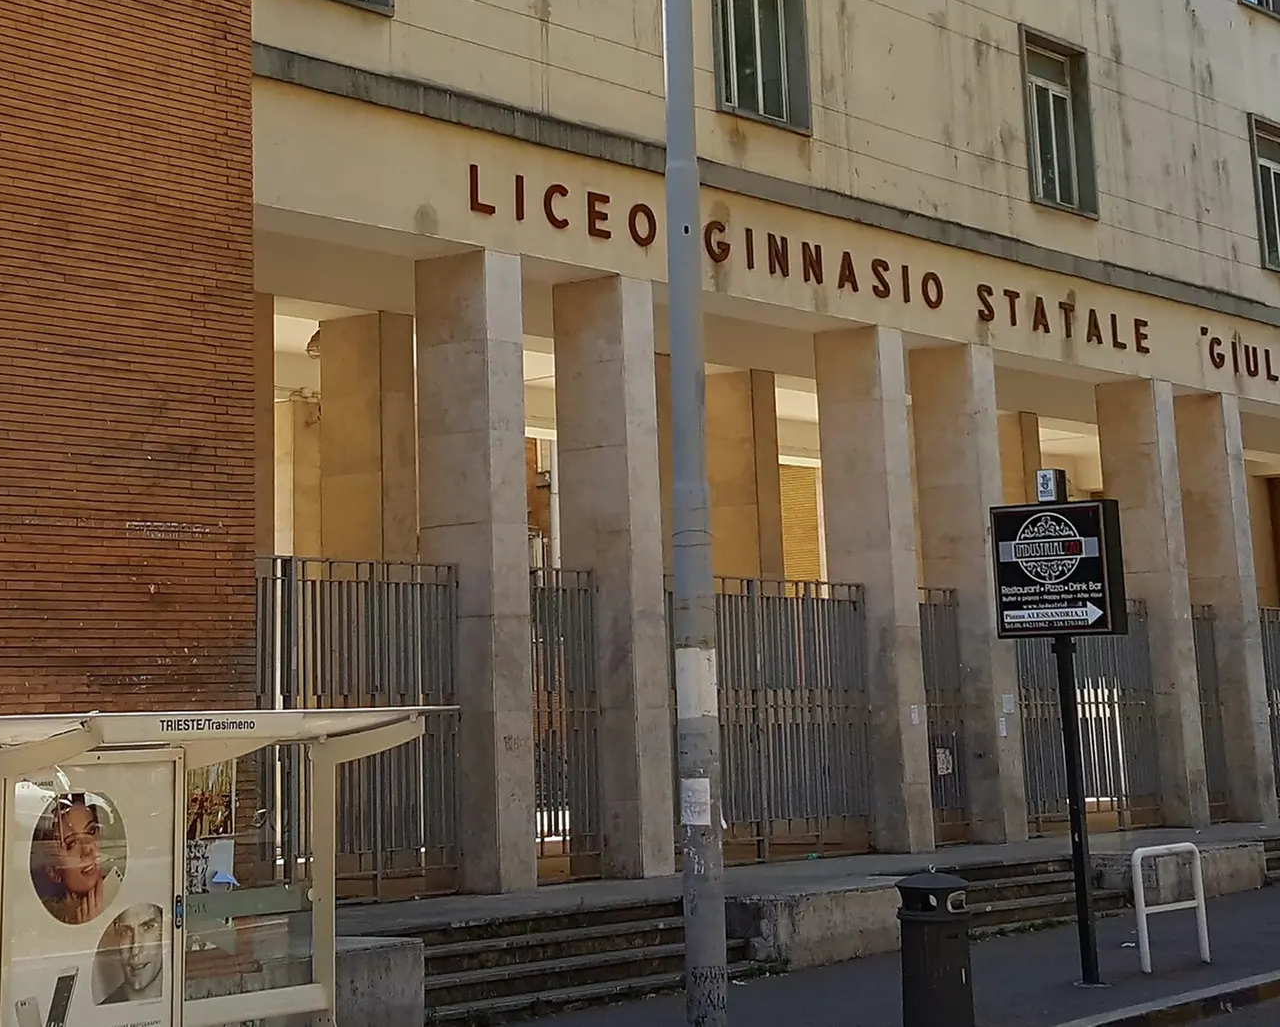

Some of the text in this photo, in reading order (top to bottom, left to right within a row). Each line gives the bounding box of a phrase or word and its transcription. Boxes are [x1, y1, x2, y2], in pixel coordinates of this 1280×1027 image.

[468, 163, 657, 247] LICEO
[704, 220, 944, 310] GINNASIO
[976, 283, 1151, 354] STATALE
[1001, 581, 1102, 594] Restaurant Pizza Drink Bar
[159, 718, 256, 732] TRIESTE/Trasimeno
